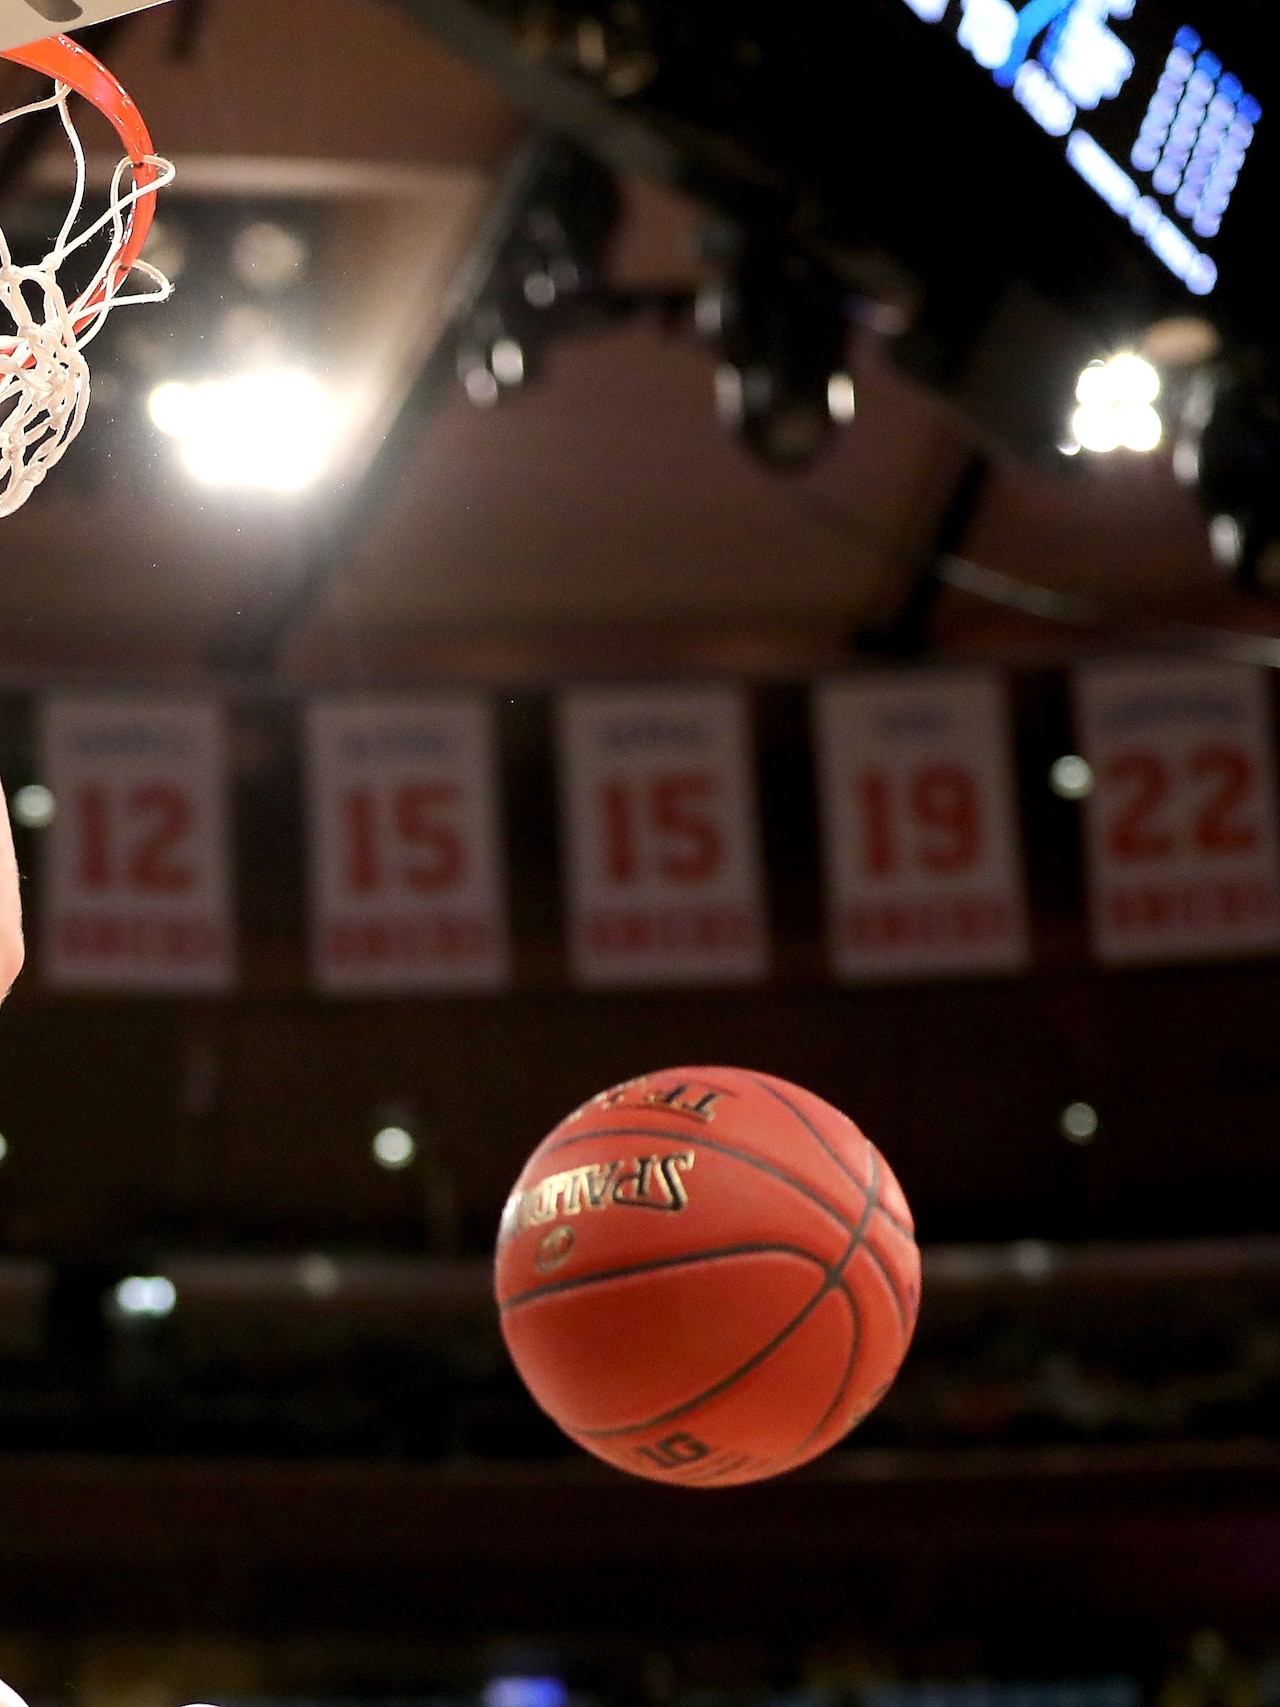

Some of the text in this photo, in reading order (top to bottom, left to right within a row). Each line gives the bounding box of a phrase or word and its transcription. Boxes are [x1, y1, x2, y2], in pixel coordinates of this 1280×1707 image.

[75, 781, 196, 892] 12
[342, 784, 467, 896] 15
[600, 769, 724, 888] 15
[859, 760, 982, 879] 19
[1106, 743, 1258, 860] 22
